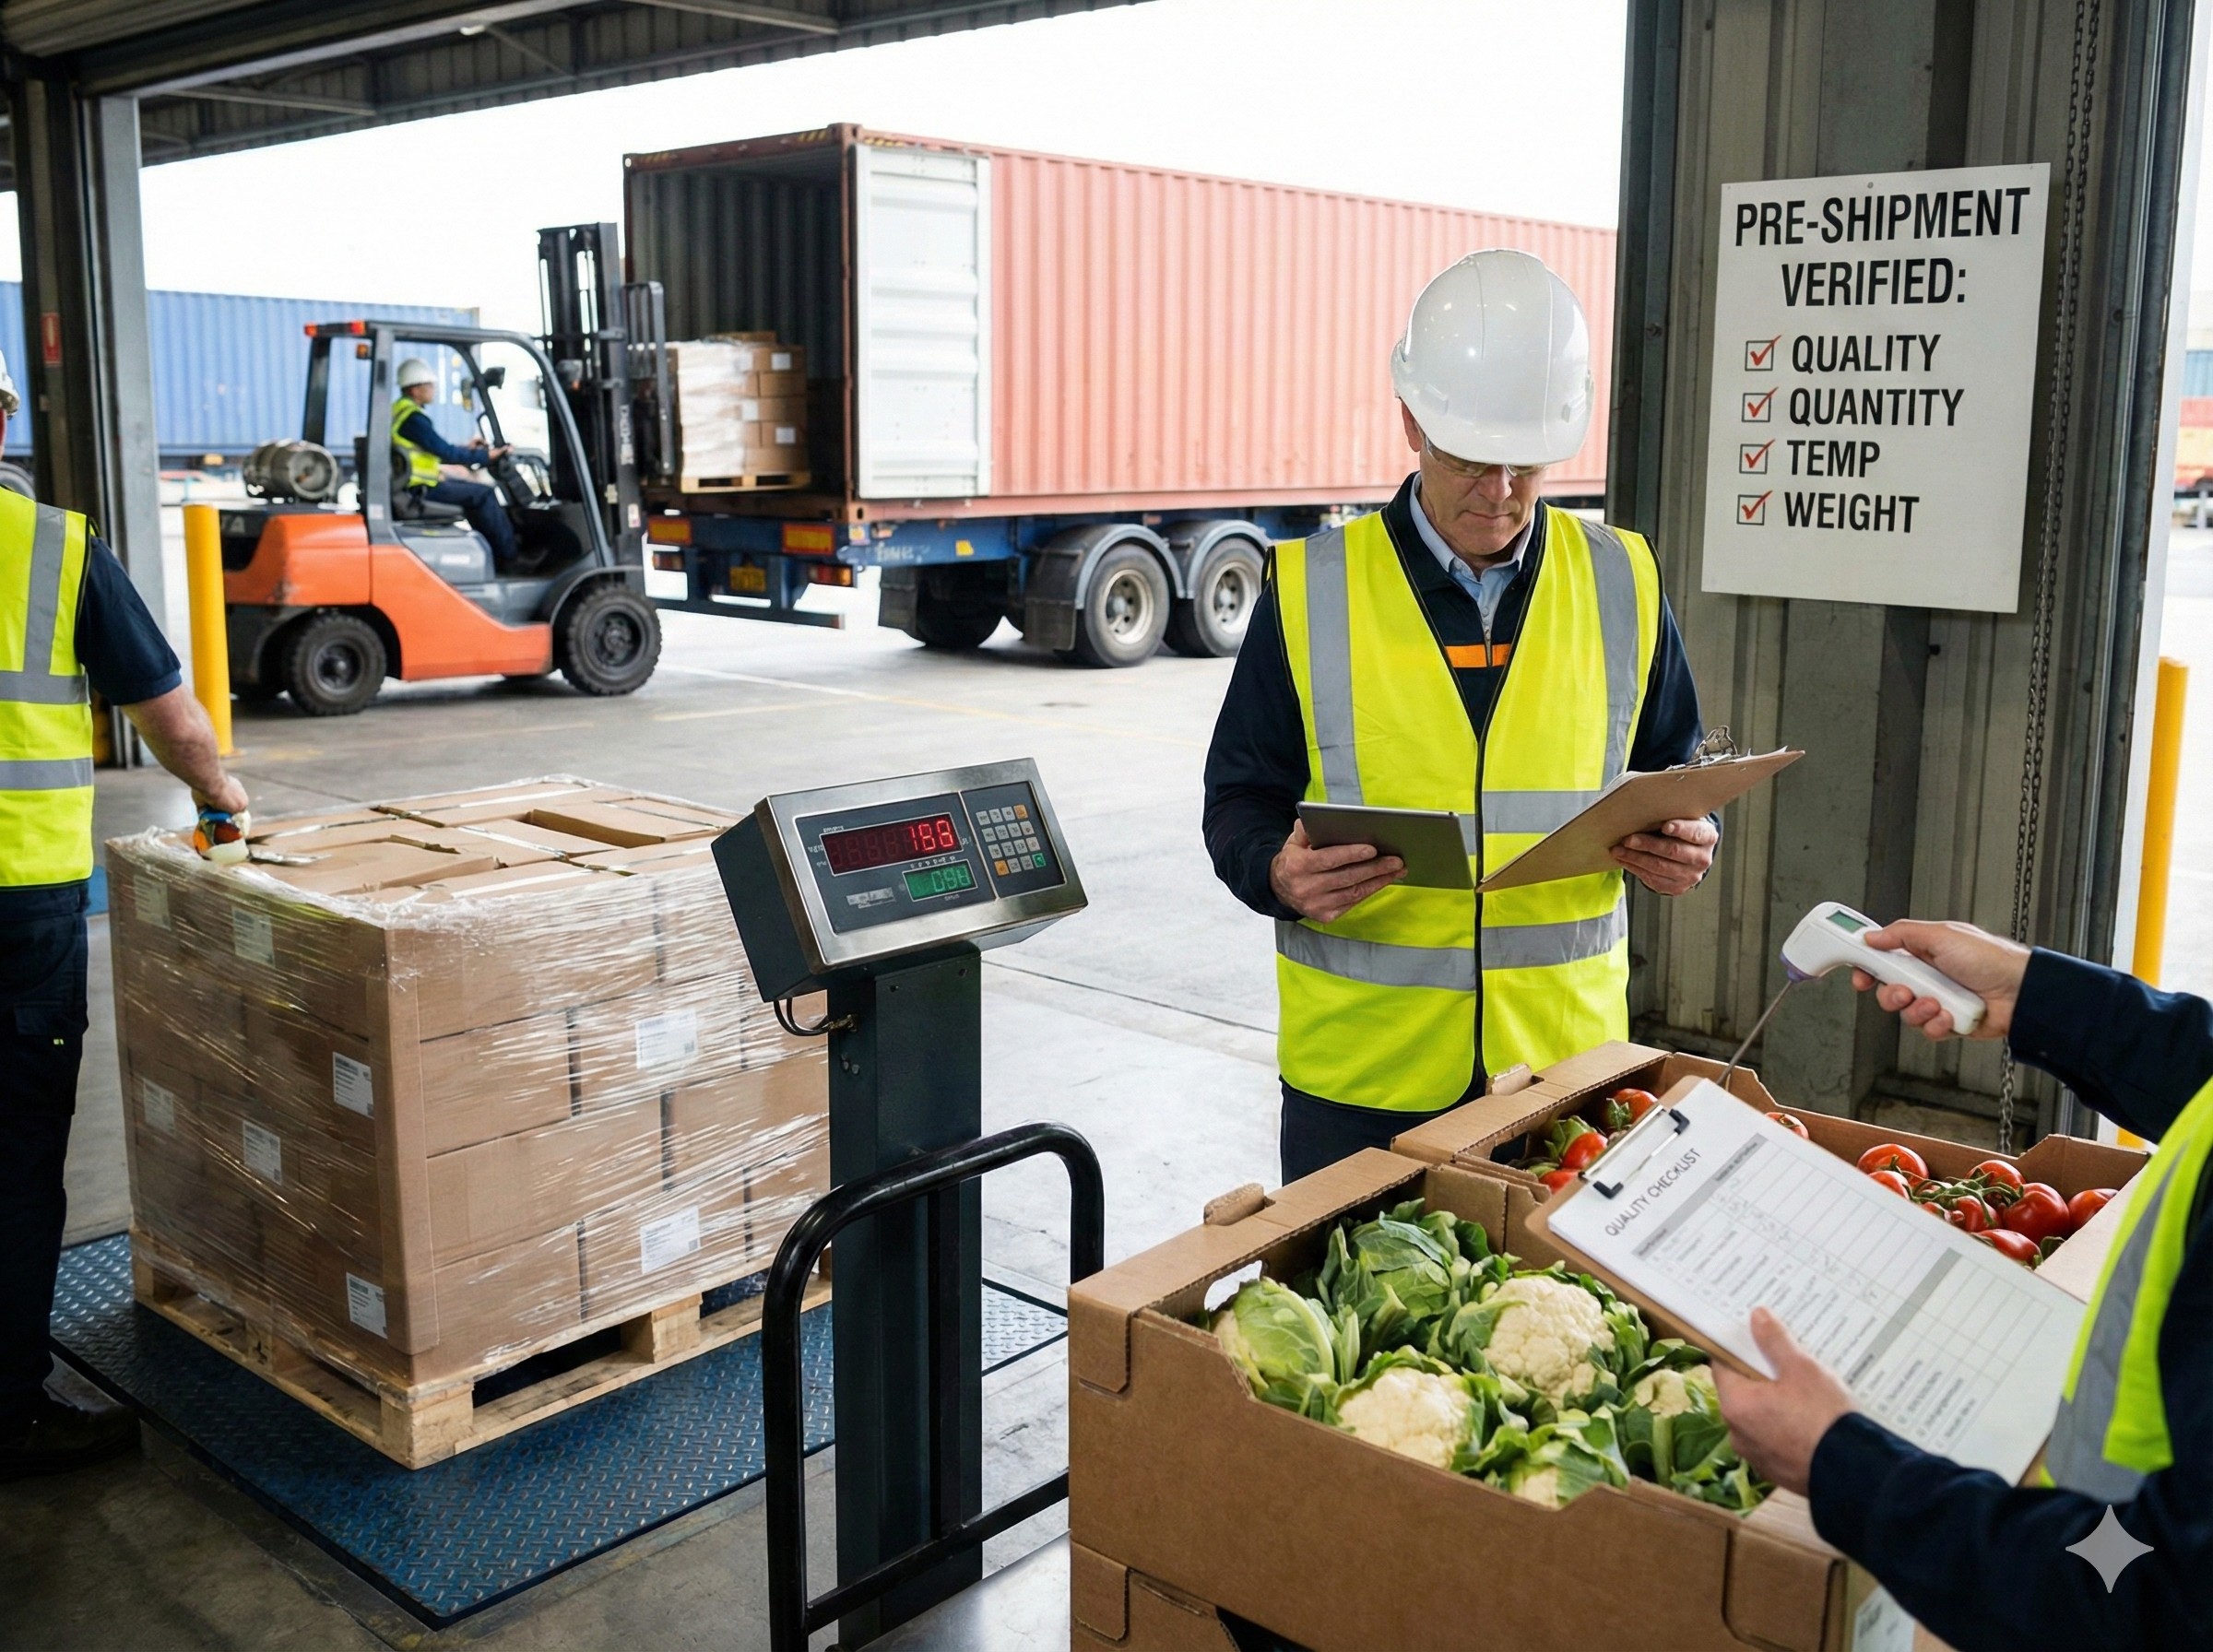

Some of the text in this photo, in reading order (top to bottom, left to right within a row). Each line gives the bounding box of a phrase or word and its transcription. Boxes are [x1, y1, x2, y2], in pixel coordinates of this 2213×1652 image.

[1735, 187, 2030, 246] PRE-SHIPMENT
[1781, 257, 1966, 306] VERIFIED:
[1792, 334, 1941, 374] QUALITY
[1789, 388, 1965, 427] QUANTITY
[1786, 440, 1880, 478] TEMP
[1783, 491, 1920, 533] WEIGHT
[1605, 1195, 1651, 1236] QUALITY
[1648, 1149, 1701, 1198] CHECKLIST
